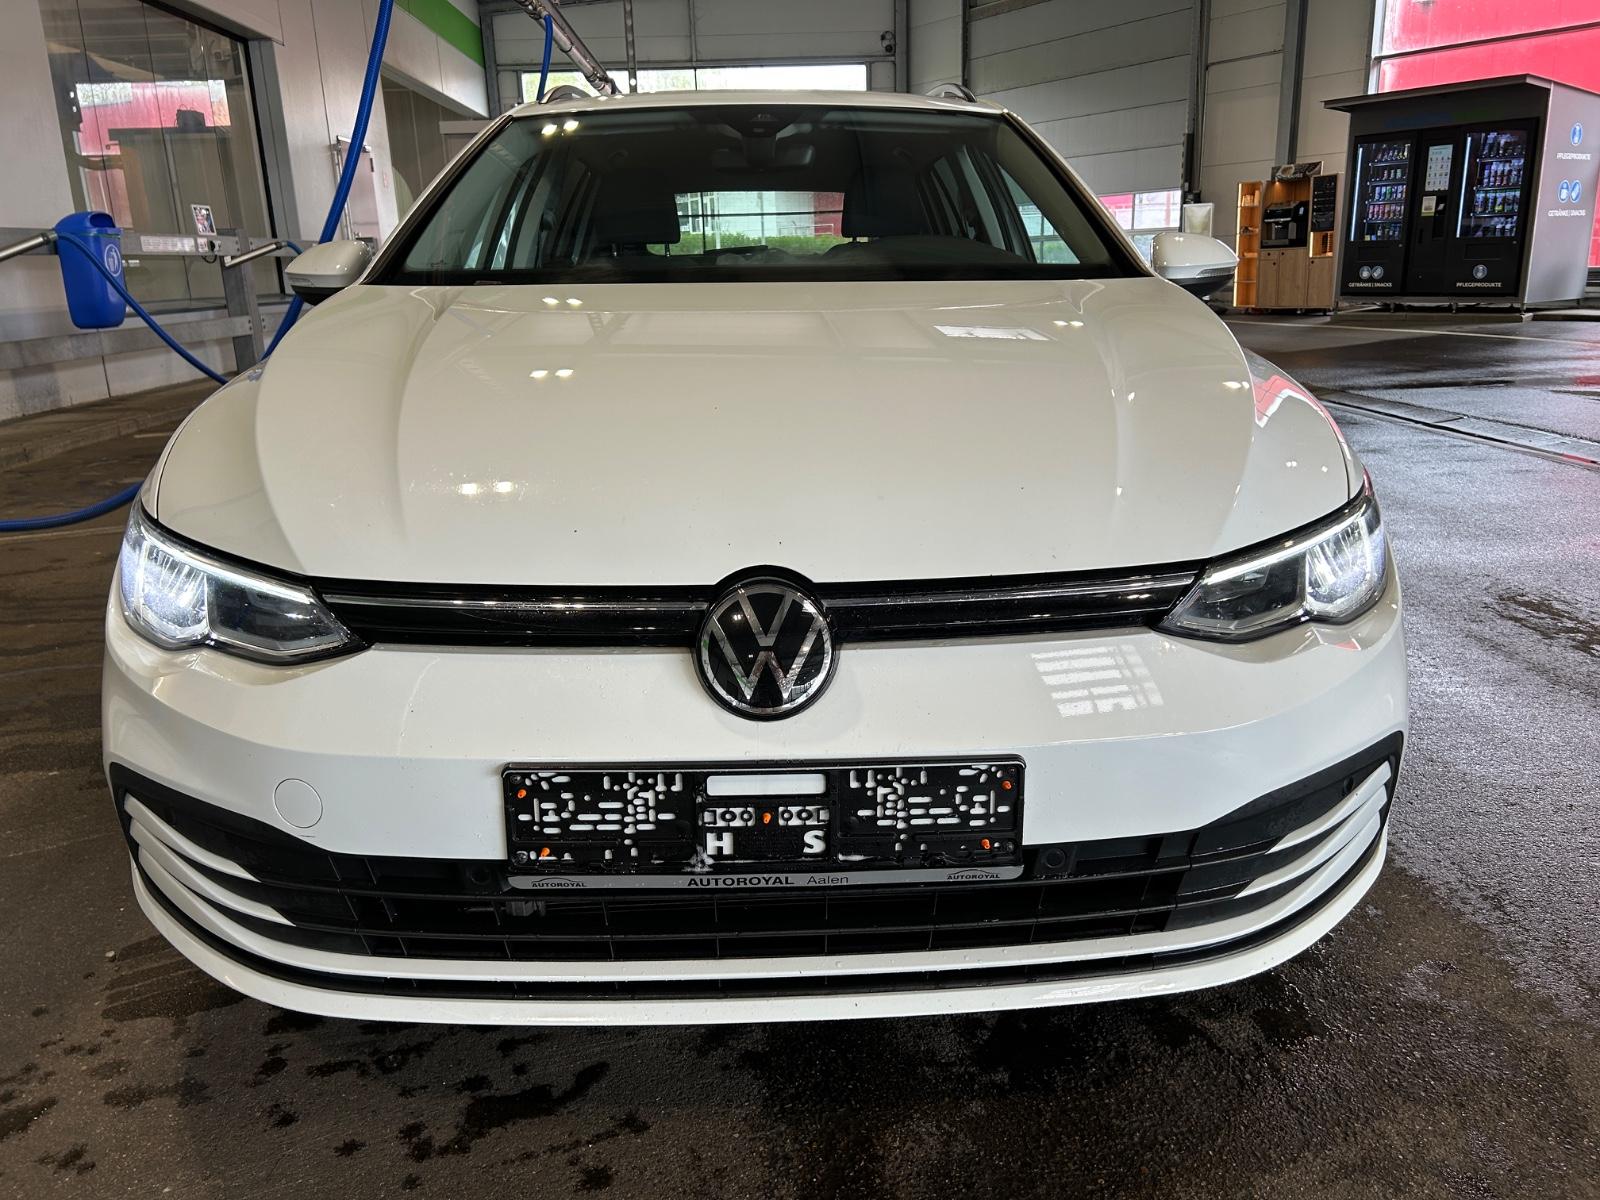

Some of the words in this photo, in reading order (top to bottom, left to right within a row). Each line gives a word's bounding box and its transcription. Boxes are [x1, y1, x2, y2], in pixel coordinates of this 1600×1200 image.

[706, 832, 734, 856] H
[803, 830, 826, 854] S
[687, 876, 795, 887] AUTOROYAL
[806, 875, 849, 886] Aalen
